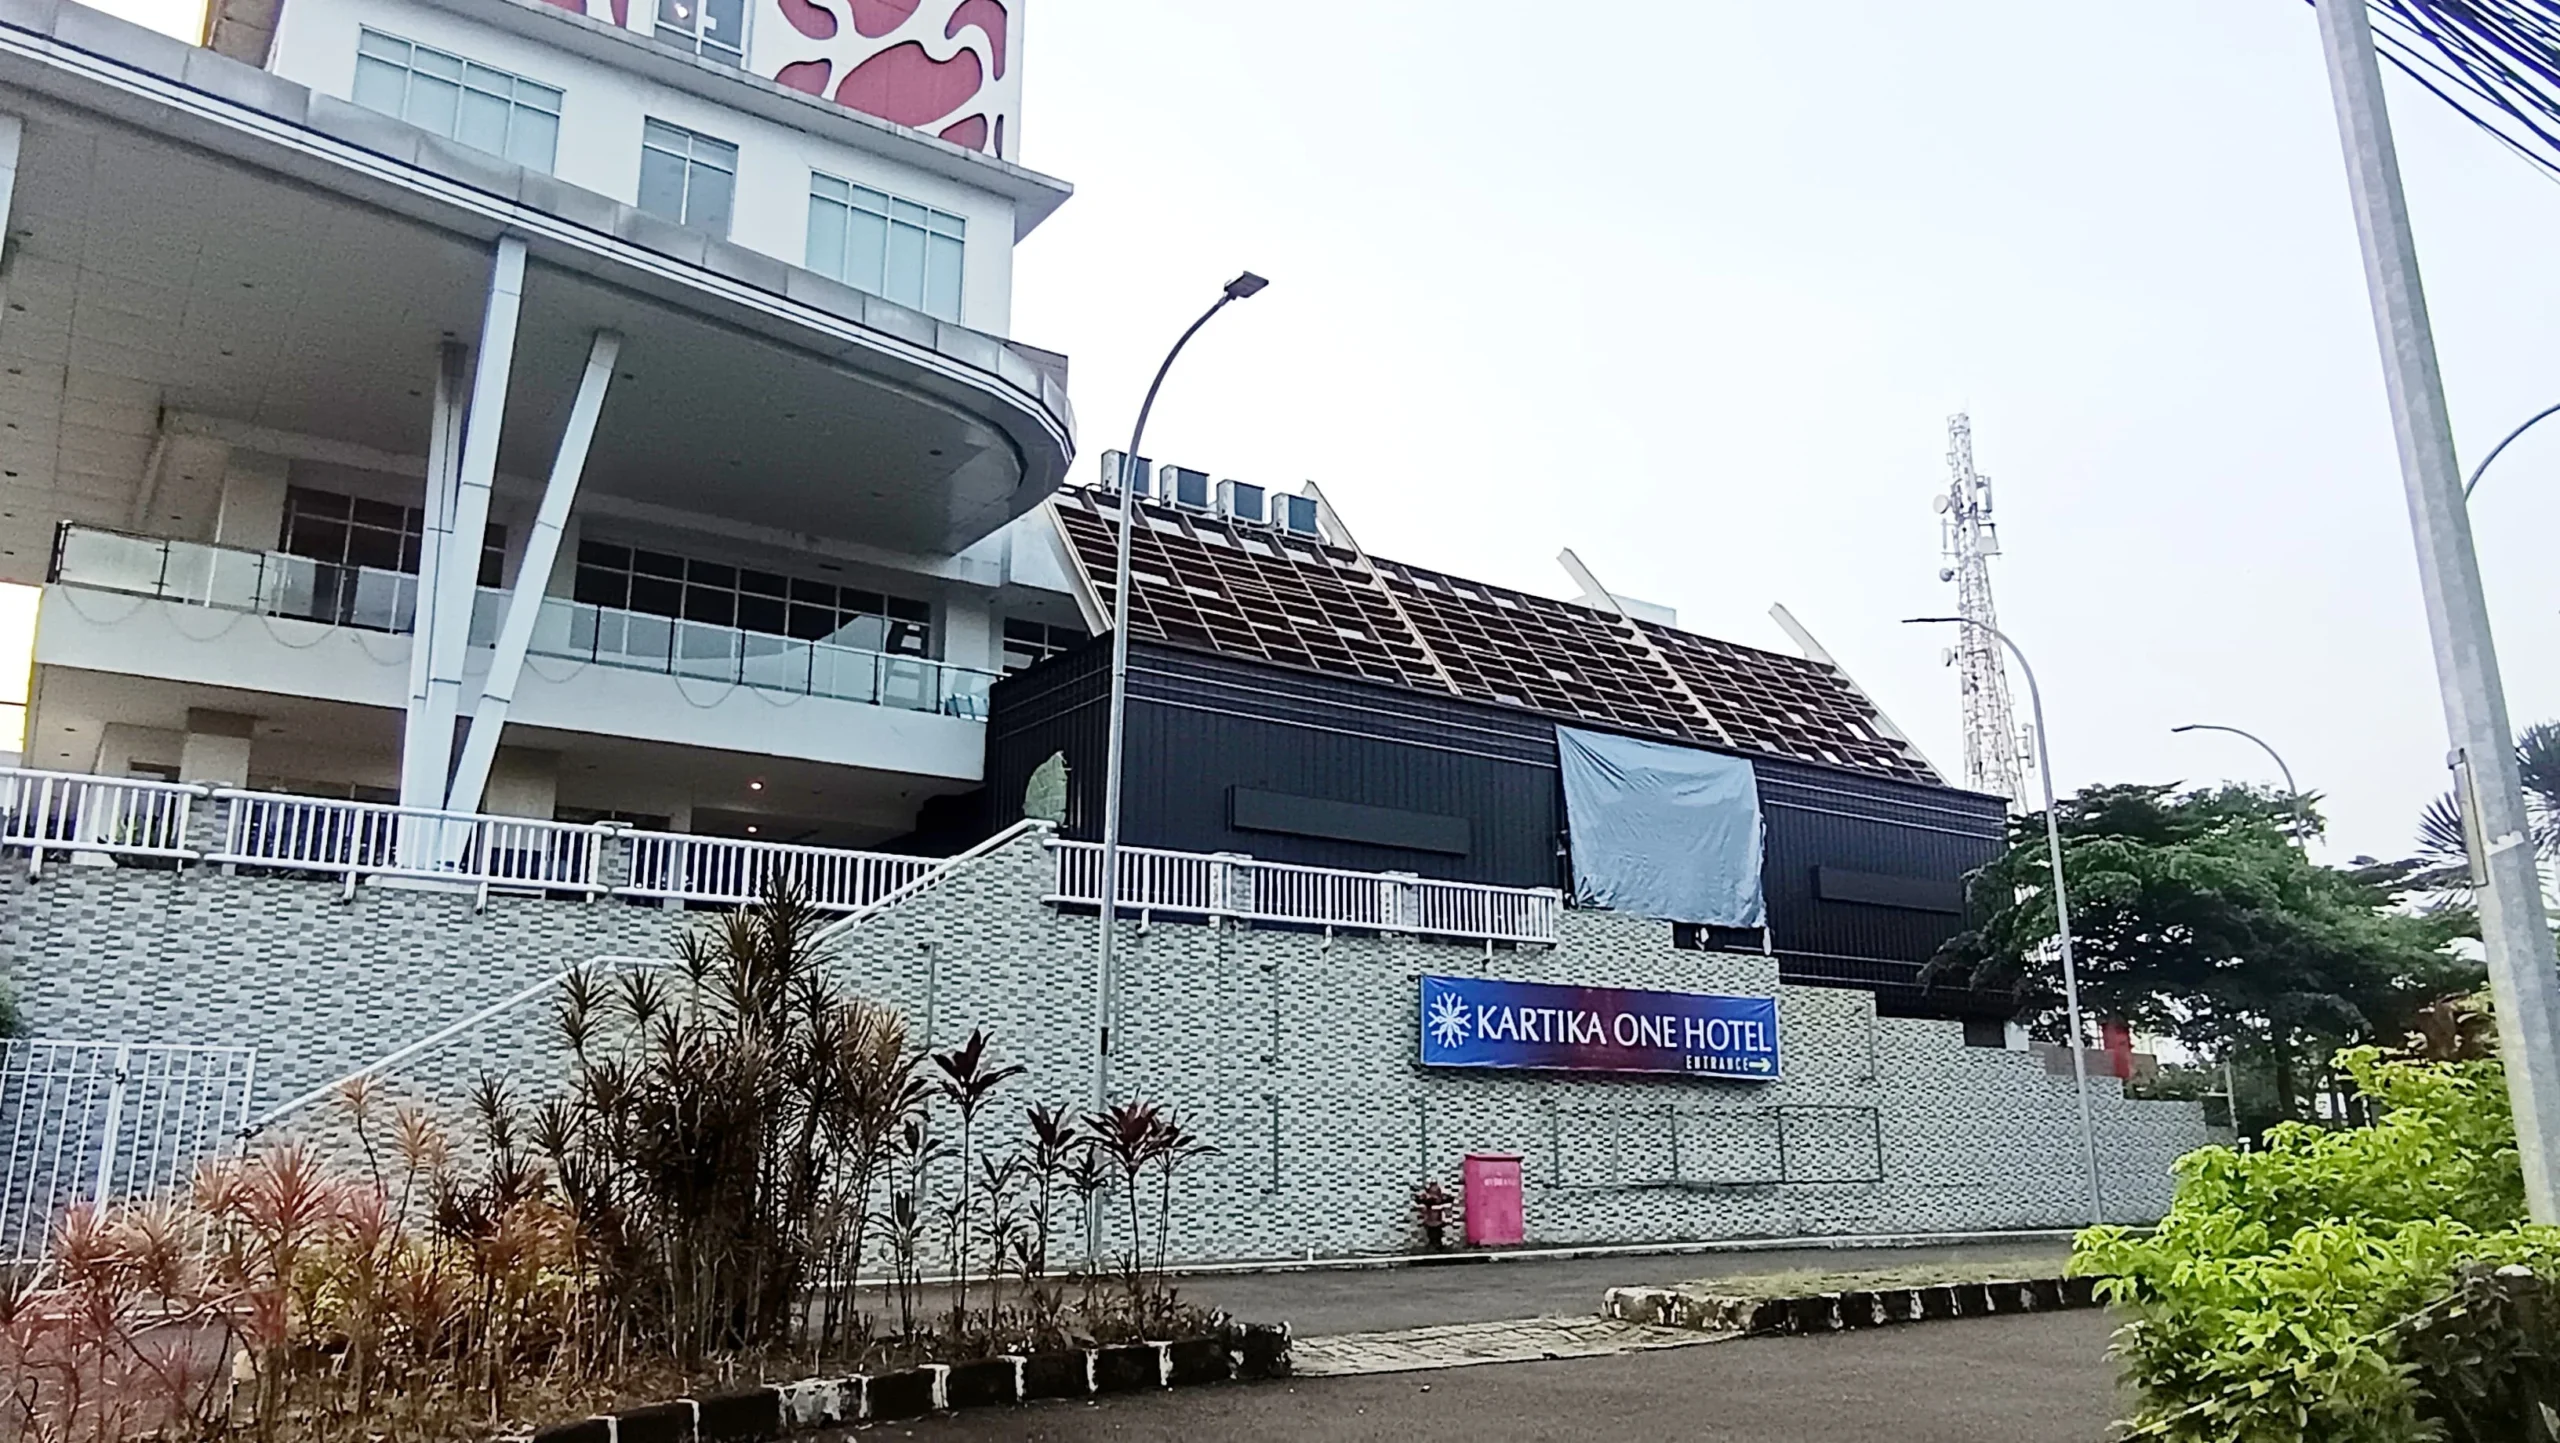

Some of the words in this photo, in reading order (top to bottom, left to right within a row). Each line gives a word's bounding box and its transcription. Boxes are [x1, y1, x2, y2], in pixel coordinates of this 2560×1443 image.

[1477, 1005, 1607, 1045] KARTIKA
[1614, 1013, 1678, 1048] ONE
[1684, 1017, 1772, 1052] HOTEL
[1686, 1055, 1749, 1071] ENTRANCE
